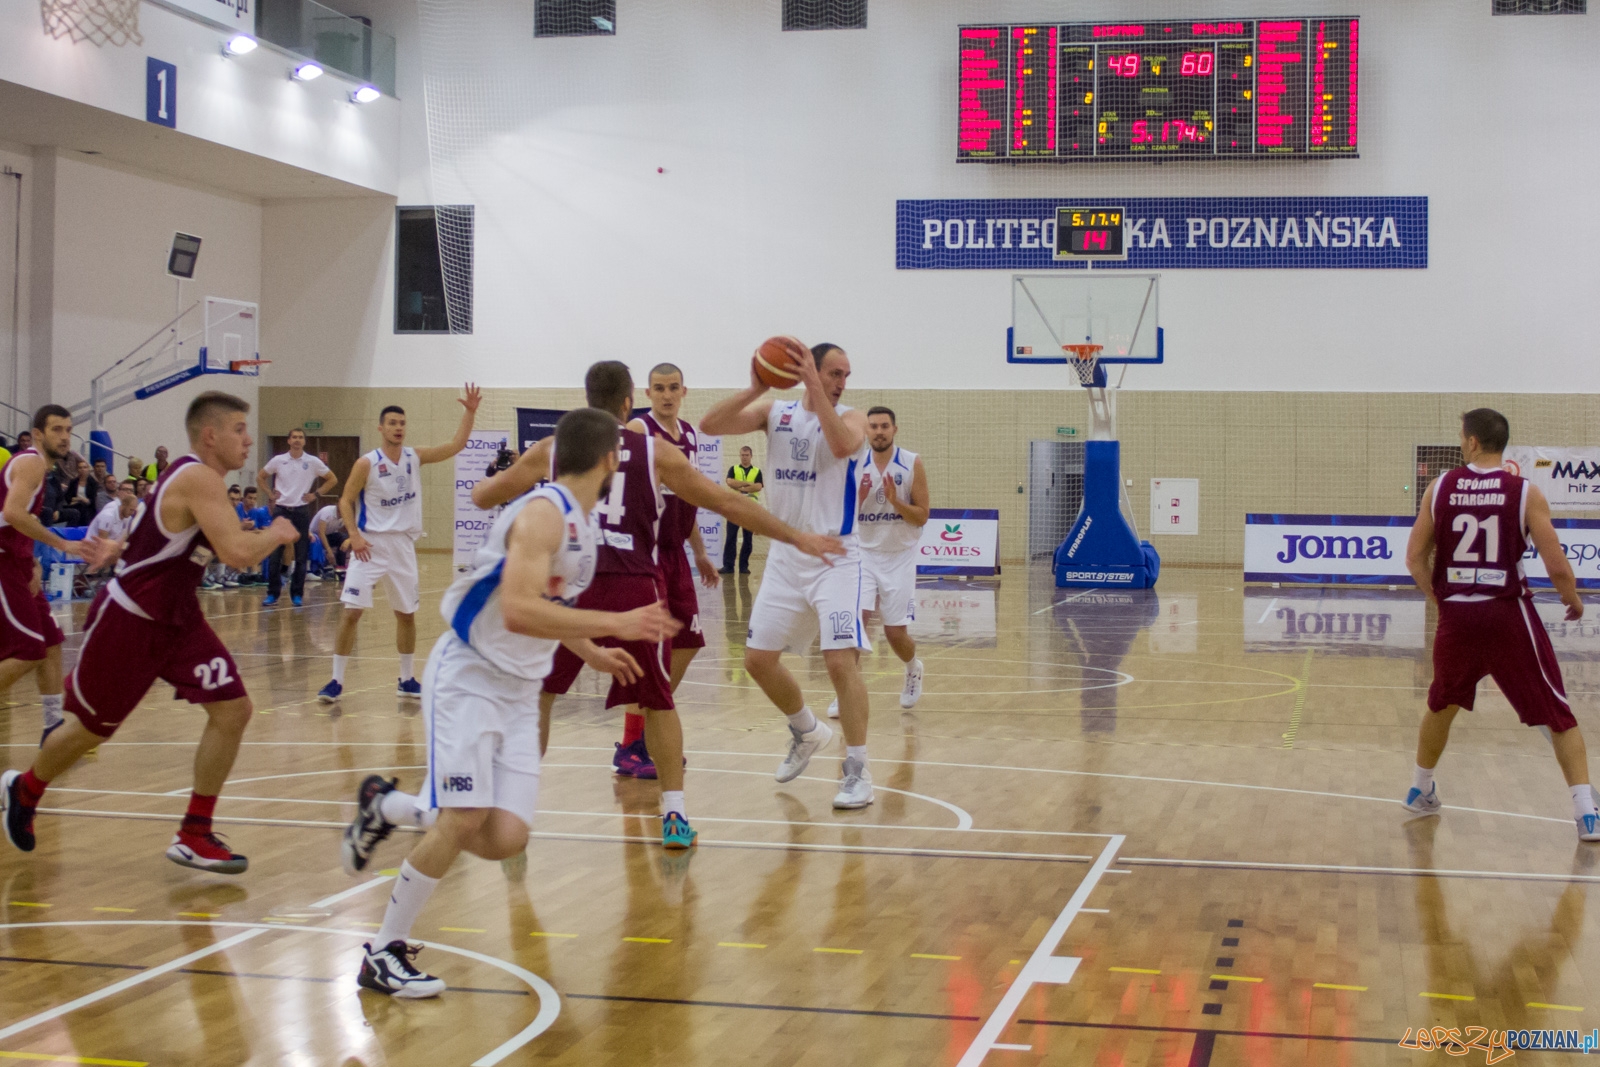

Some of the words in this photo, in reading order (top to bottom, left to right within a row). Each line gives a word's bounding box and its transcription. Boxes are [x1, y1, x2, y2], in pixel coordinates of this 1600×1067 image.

[1108, 53, 1141, 77] 49
[1152, 65, 1161, 76] 4
[1180, 52, 1214, 76] 60
[1243, 55, 1252, 67] 3
[157, 69, 168, 120] 1
[1084, 92, 1094, 104] 2
[1243, 90, 1252, 100] 4
[1204, 121, 1213, 131] 4
[922, 217, 1172, 250] POLITECKA
[1186, 210, 1401, 249] POZNAŃSKA
[1082, 230, 1108, 251] 14
[790, 437, 810, 461] 12
[1568, 483, 1589, 493] hit
[1449, 493, 1506, 506] STARGARD
[1067, 515, 1093, 559] HYDROPLAY
[1452, 513, 1499, 563] 21
[920, 545, 981, 557] CYMES
[829, 611, 854, 634] 12
[193, 656, 235, 690] 22
[449, 776, 473, 792] PBG
